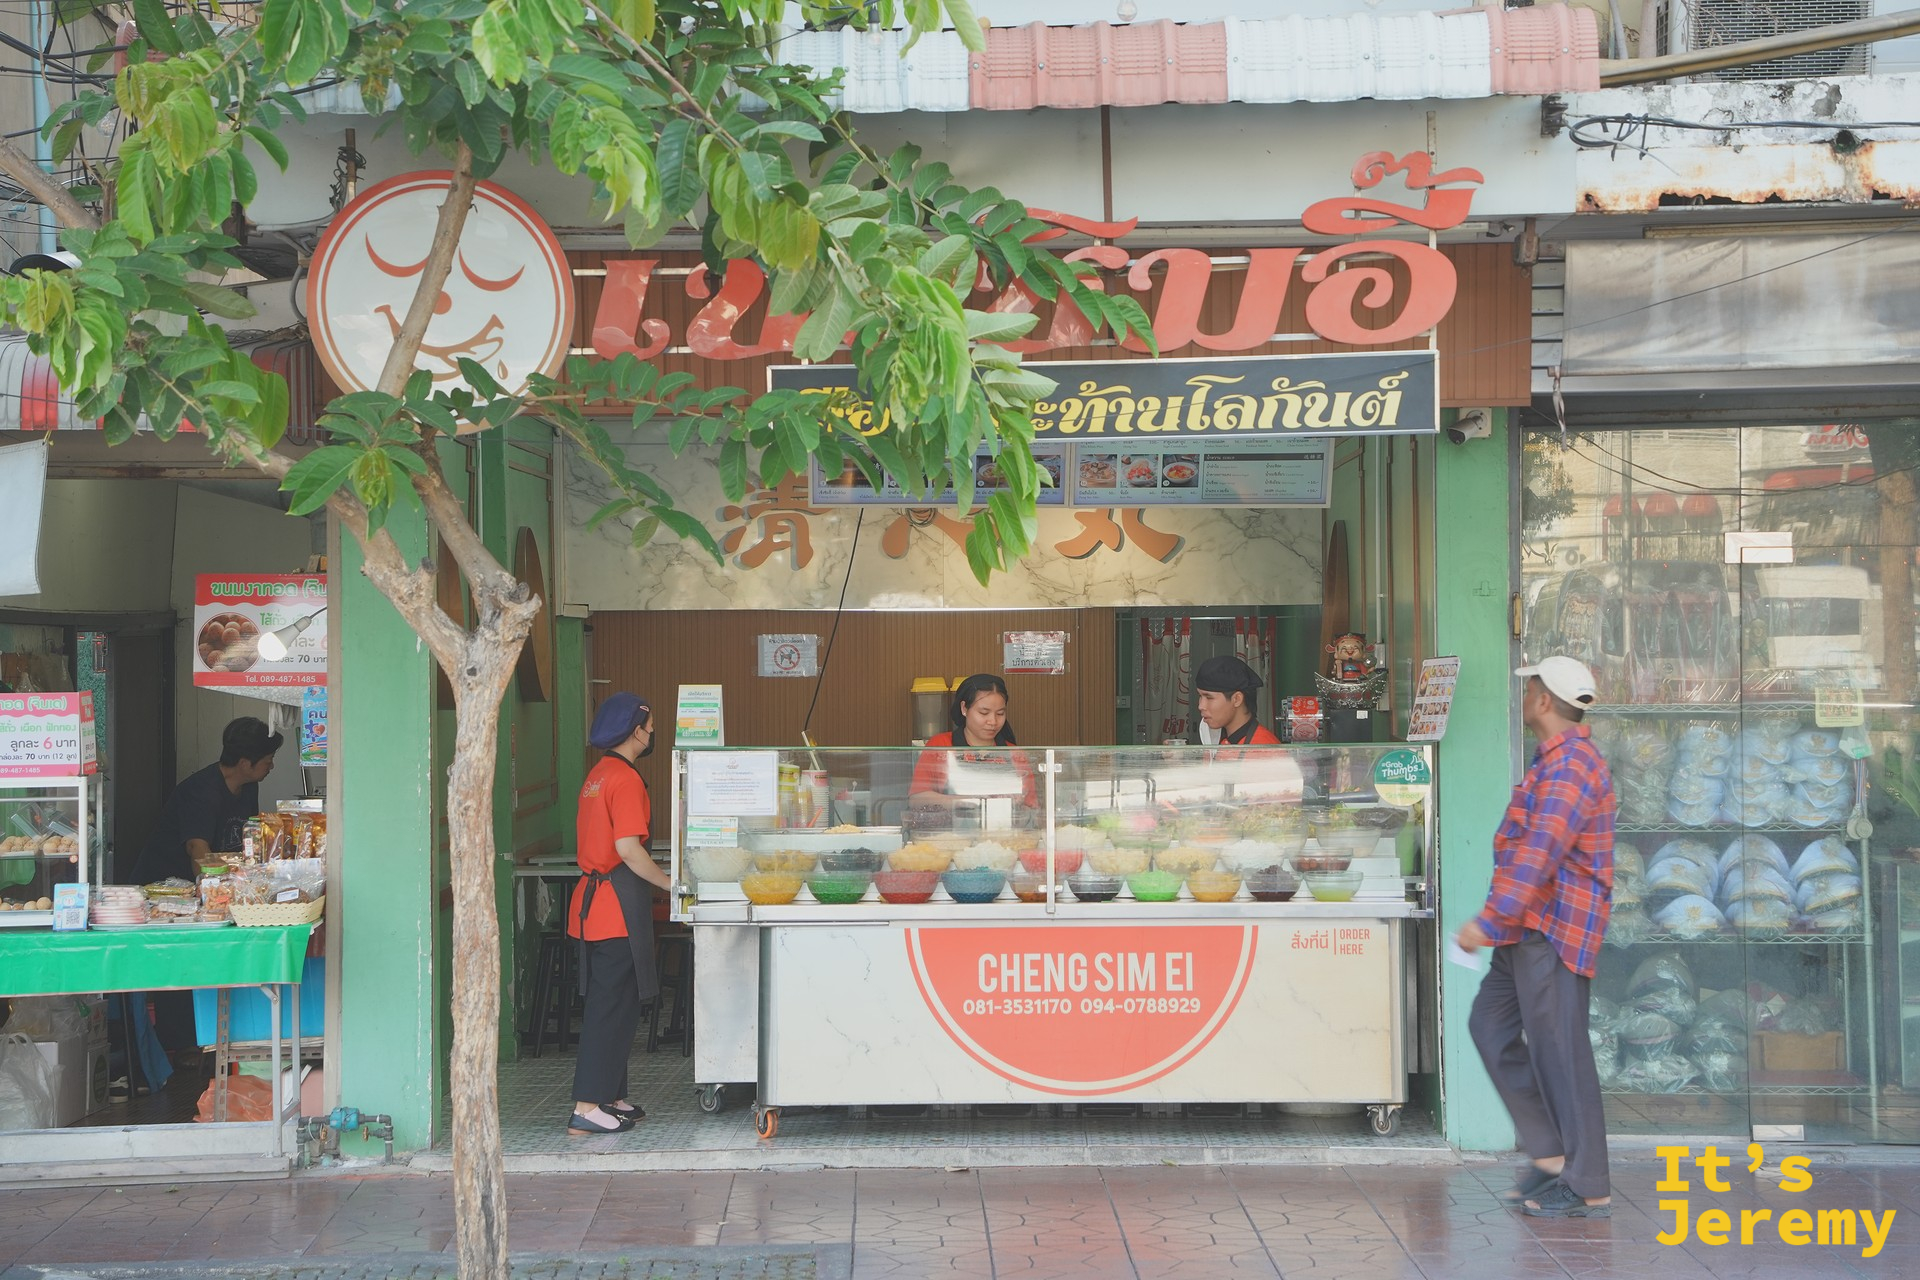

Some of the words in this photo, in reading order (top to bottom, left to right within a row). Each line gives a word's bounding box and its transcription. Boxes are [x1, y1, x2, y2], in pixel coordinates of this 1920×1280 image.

[211, 582, 297, 597] ขนมงาทอด
[298, 654, 310, 663] 70
[245, 675, 257, 683] Tel.
[260, 675, 316, 683] 089-487-1485
[10, 739, 39, 752] ลูกละ
[43, 736, 53, 750] 6
[55, 739, 77, 748] บาท
[1382, 764, 1418, 778] Thumbs
[1404, 773, 1417, 783] Up
[1290, 928, 1329, 950] สั่งที่นี่
[1339, 928, 1371, 940] ORDER
[1339, 943, 1364, 955] HERE
[978, 952, 1088, 993] CHENG
[1094, 951, 1156, 992] SIM
[1166, 951, 1194, 992] EI
[962, 998, 1072, 1015] 081-3531170
[1080, 996, 1201, 1015] 094-0788929
